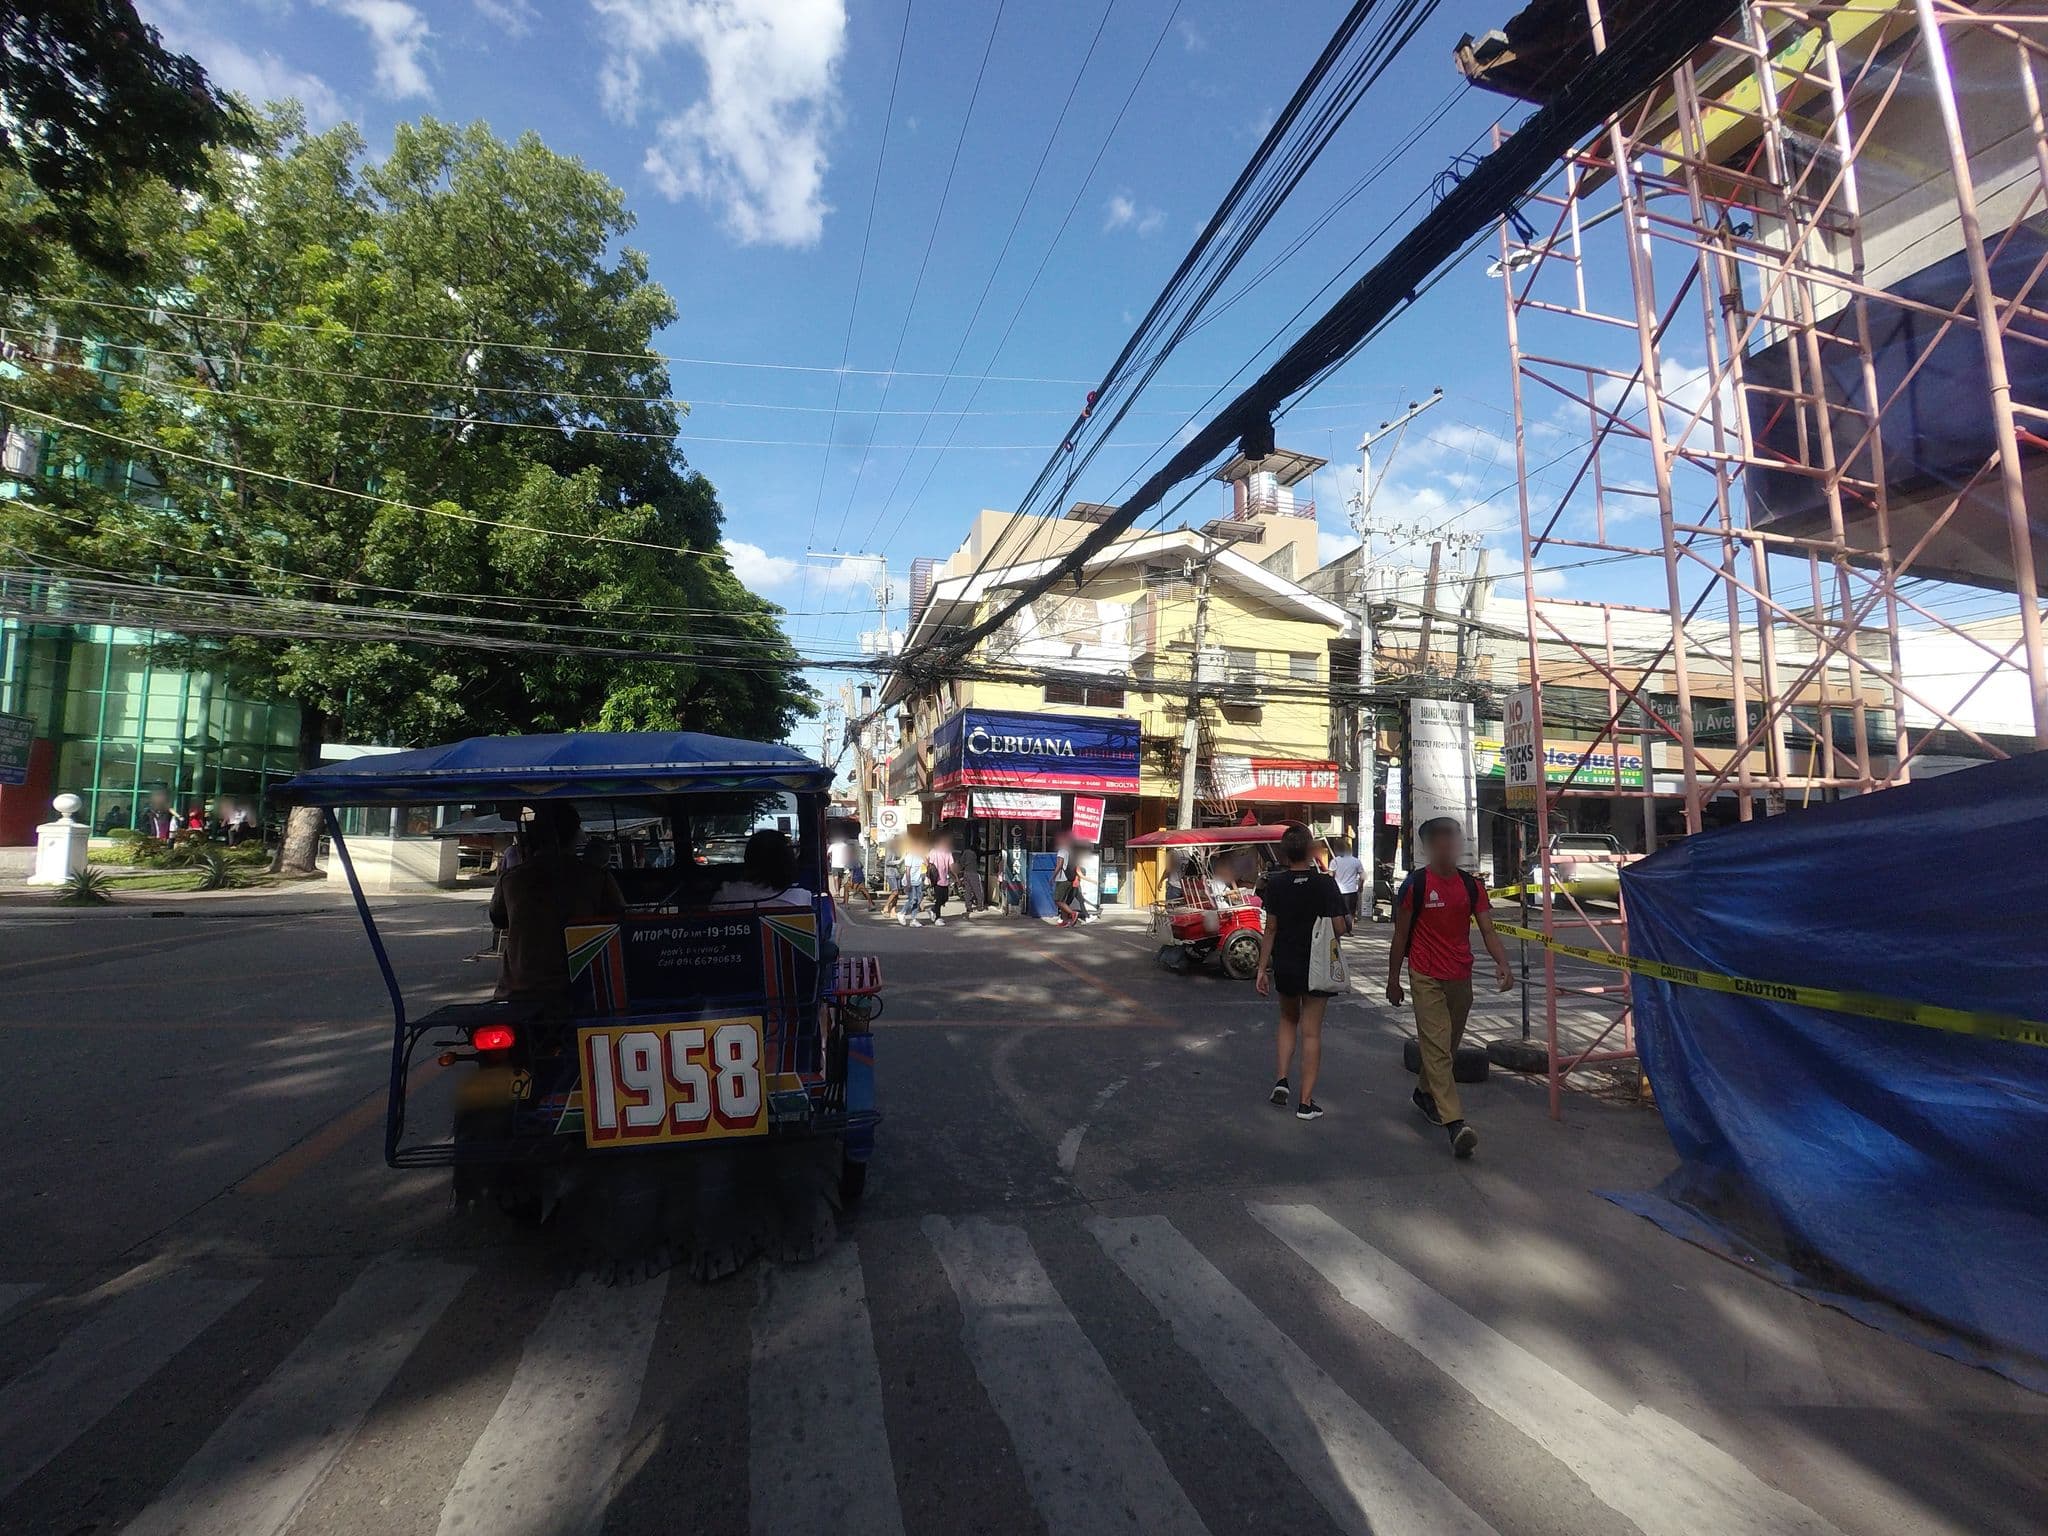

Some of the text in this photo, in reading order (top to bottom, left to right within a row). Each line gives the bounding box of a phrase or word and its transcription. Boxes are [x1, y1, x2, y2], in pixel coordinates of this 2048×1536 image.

[1508, 700, 1523, 724] NO
[1706, 713, 1758, 731] Avee
[967, 726, 1076, 758] CEBUANA
[1257, 768, 1308, 789] INTERNET
[1311, 770, 1336, 789] CAFE
[1510, 763, 1528, 782] PUB
[1558, 774, 1590, 783] OFICE
[1593, 776, 1637, 785] SUPPIES
[1593, 769, 1640, 778] ENTERRISES
[1010, 824, 1023, 882] CEBUANA
[1660, 965, 1699, 984] CAUTION
[1735, 978, 1798, 1001] CAUTION
[587, 1023, 762, 1137] 1958
